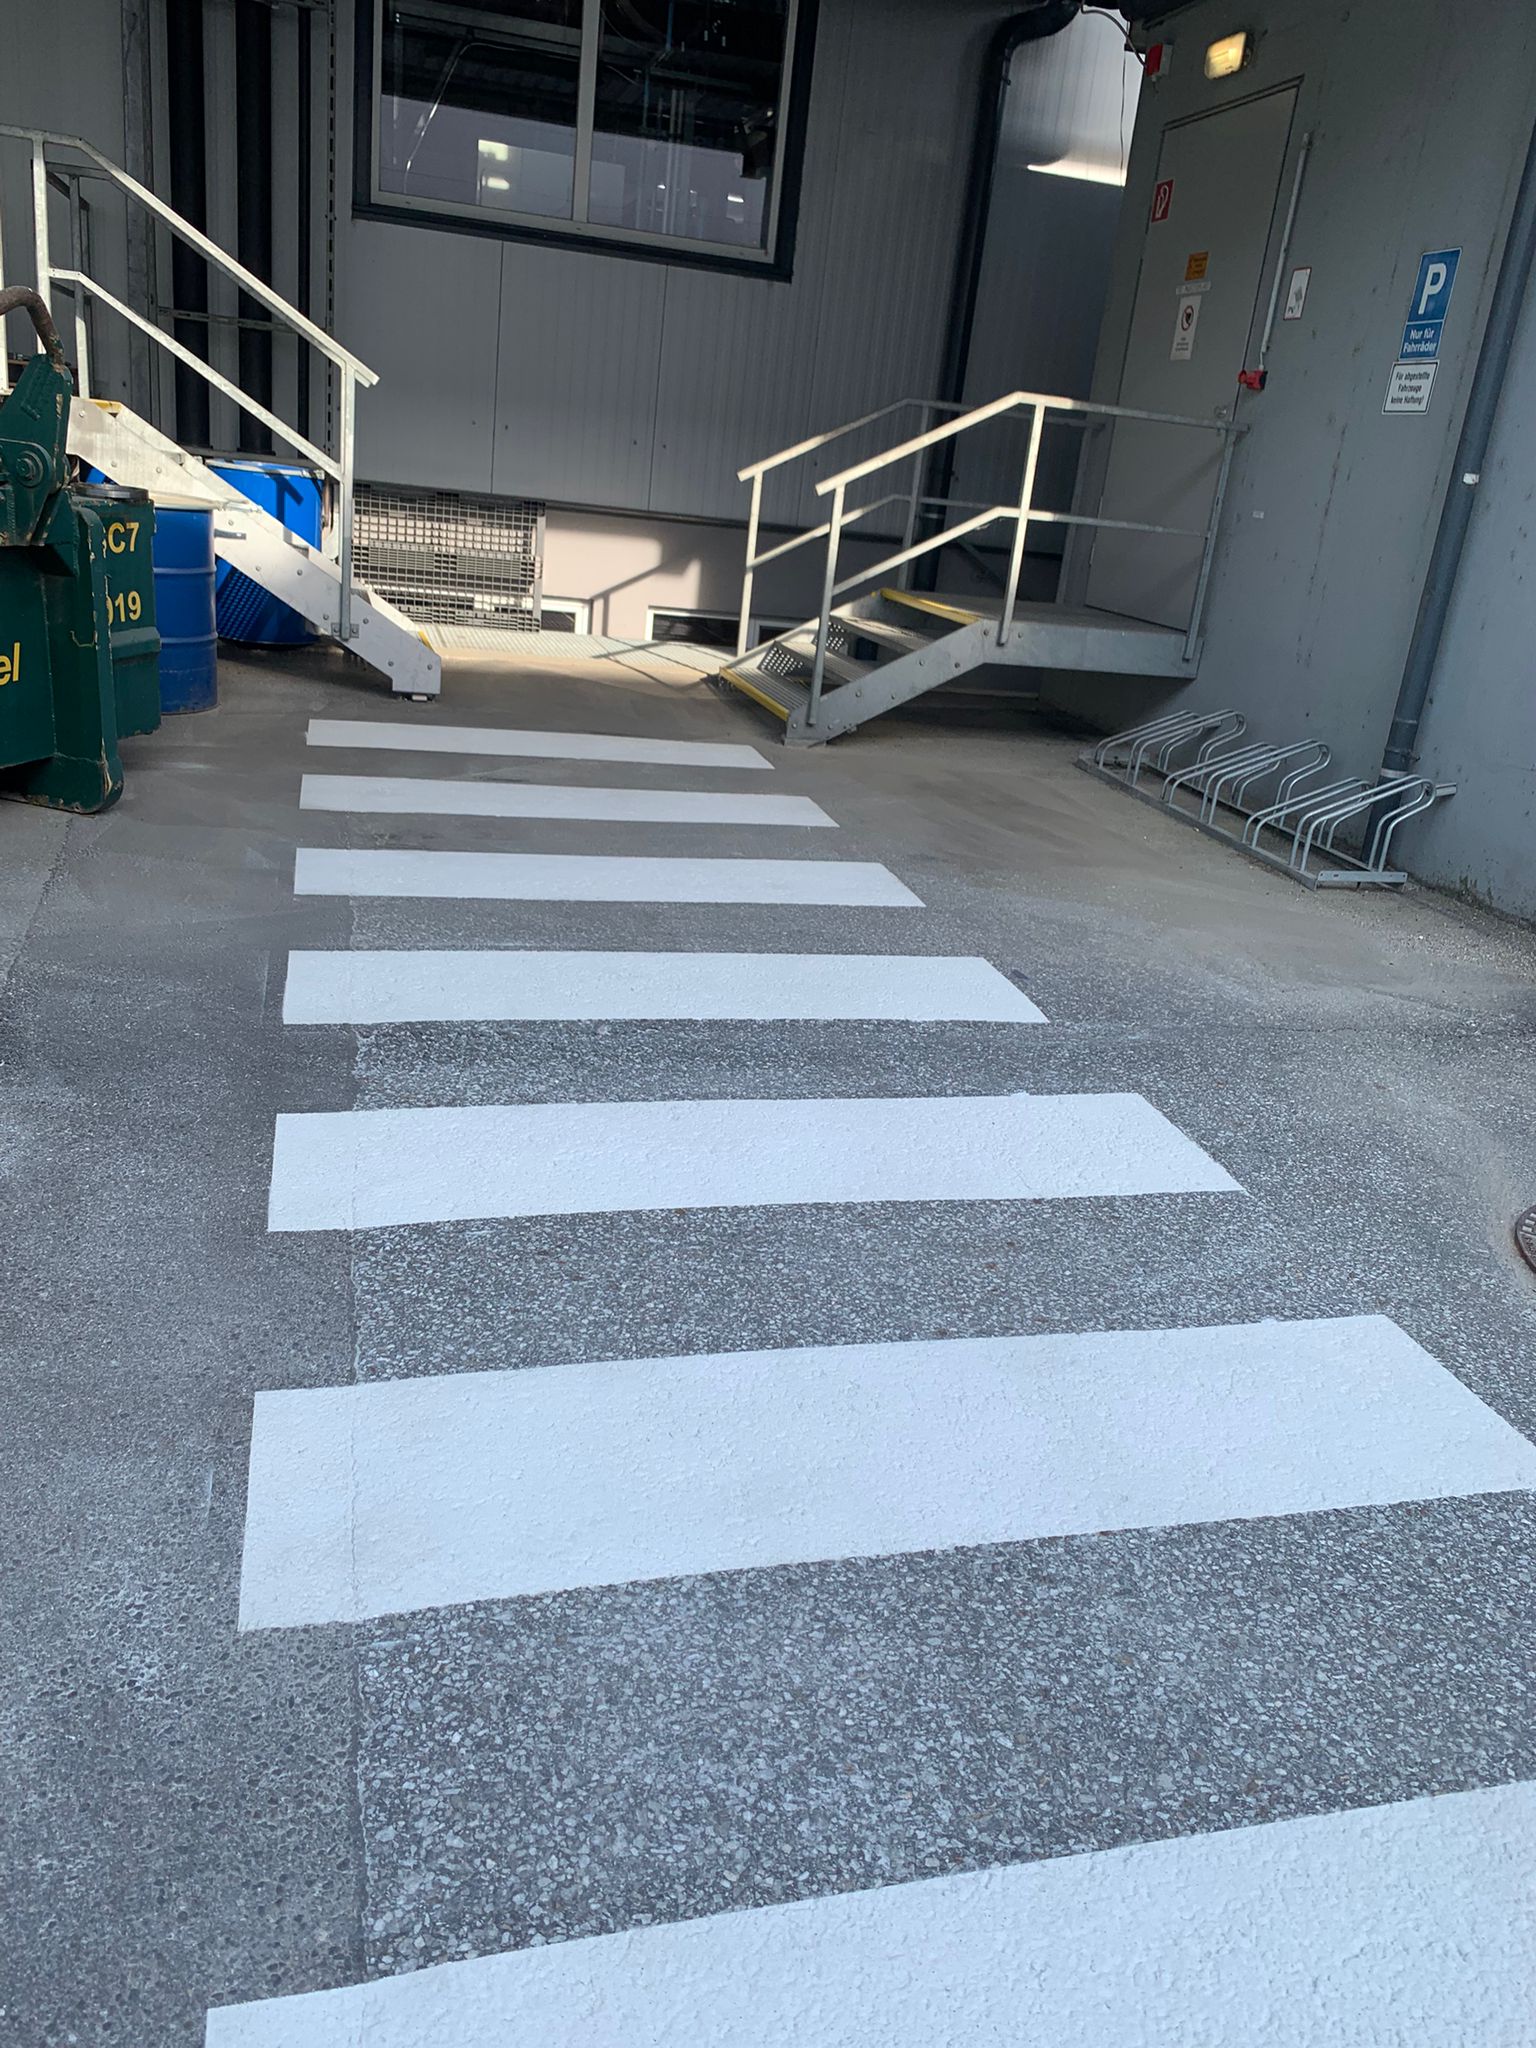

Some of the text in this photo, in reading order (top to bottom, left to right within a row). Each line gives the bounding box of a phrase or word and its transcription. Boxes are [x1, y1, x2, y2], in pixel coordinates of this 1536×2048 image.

[1418, 262, 1447, 315] P
[1410, 328, 1434, 340] Nur für
[1403, 341, 1437, 352] Fahrräder
